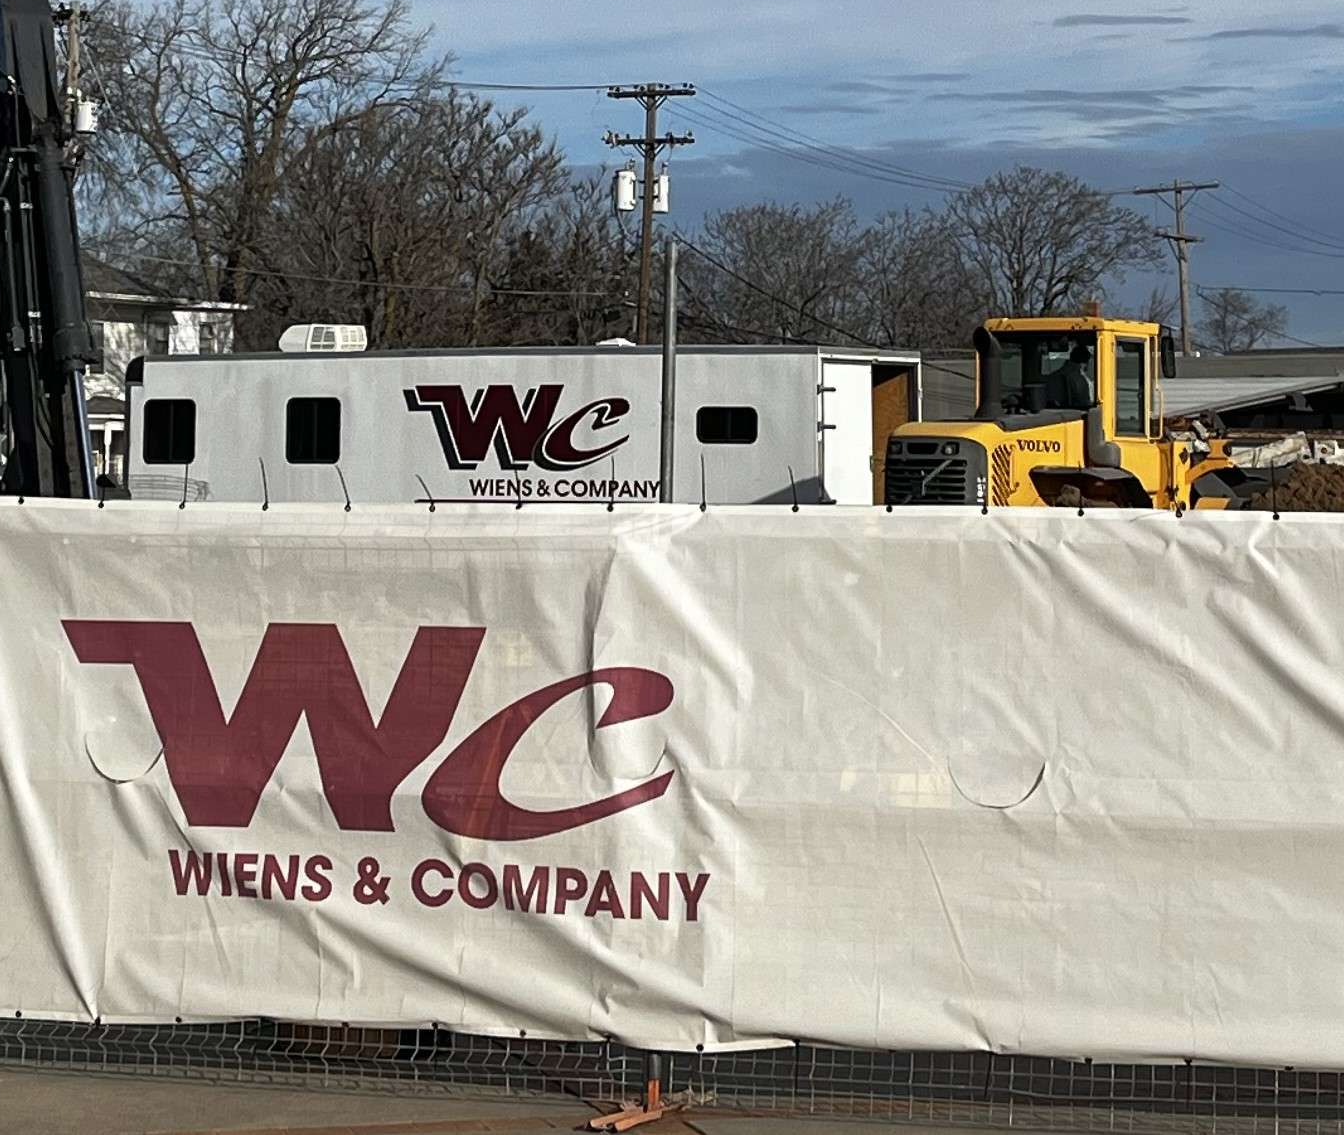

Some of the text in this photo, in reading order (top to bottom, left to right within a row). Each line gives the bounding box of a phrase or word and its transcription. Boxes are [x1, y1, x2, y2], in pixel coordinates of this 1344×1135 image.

[1016, 439, 1061, 453] VOLVO
[469, 479, 661, 498] WIENS & COMPANY
[168, 849, 711, 921] WIENS & COMPANY
